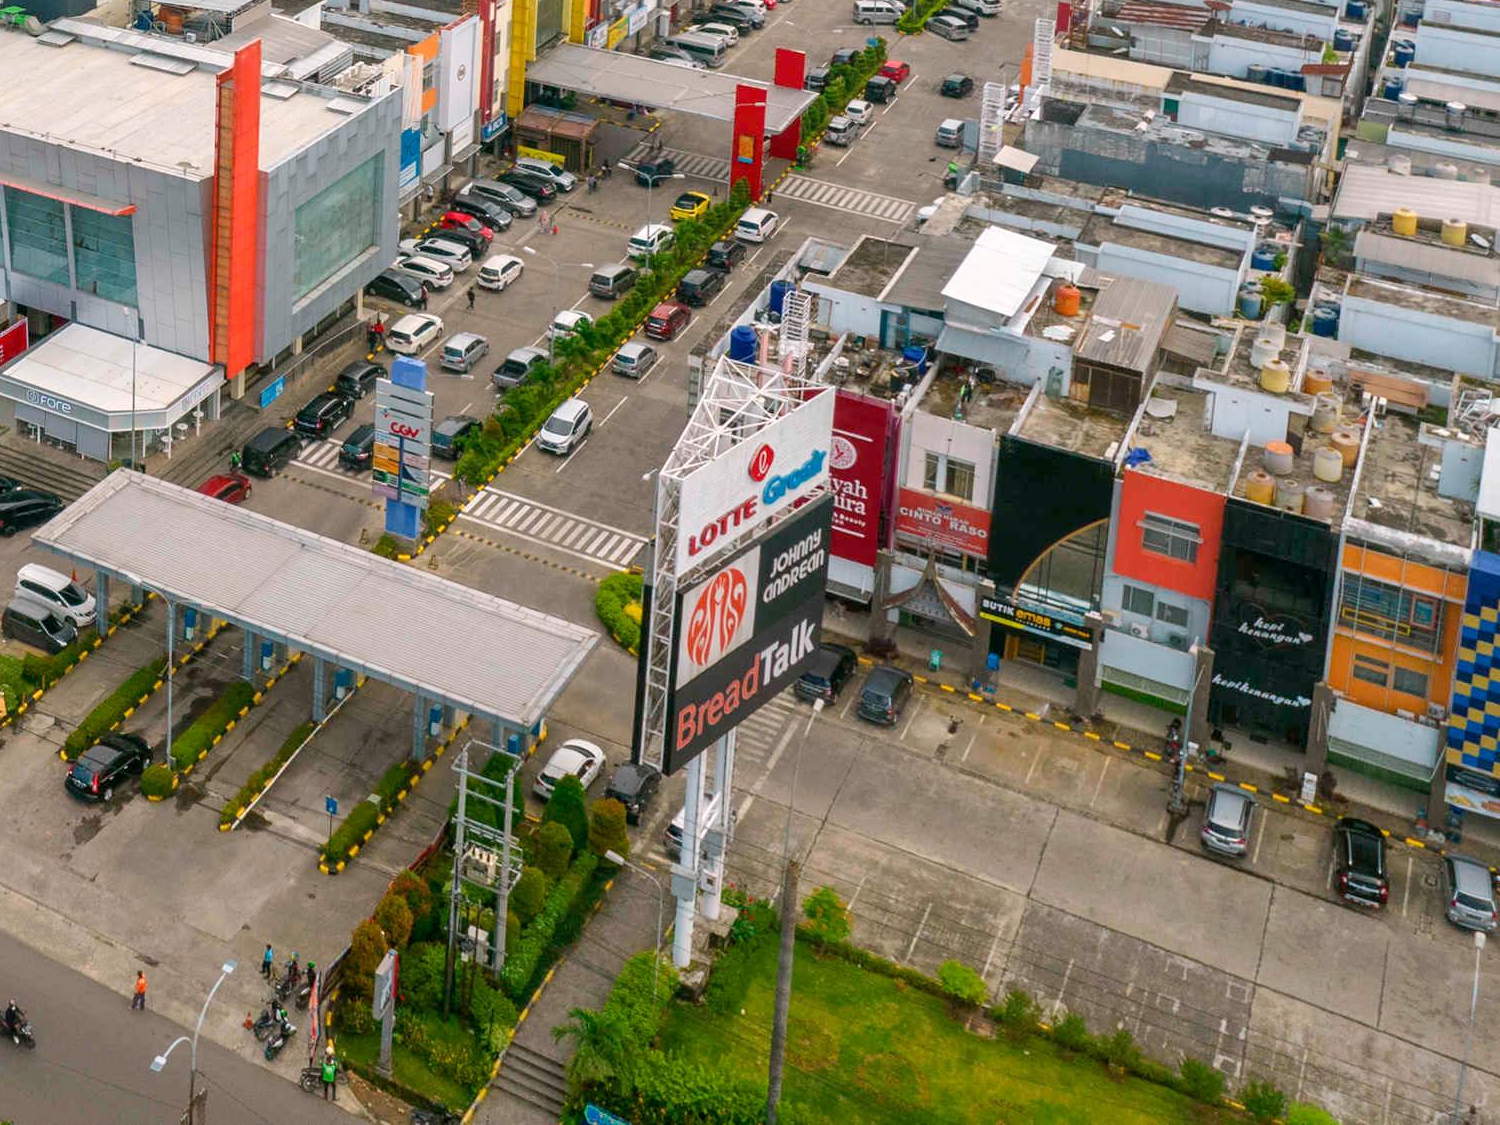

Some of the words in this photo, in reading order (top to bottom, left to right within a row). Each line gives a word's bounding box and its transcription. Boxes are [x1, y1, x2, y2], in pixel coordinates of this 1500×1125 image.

[762, 449, 827, 505] Grosir
[688, 494, 759, 556] LOTTE
[899, 506, 942, 526] CINTO
[949, 520, 988, 539] RASO
[982, 598, 1015, 616] BUTIK
[1015, 609, 1052, 628] emas
